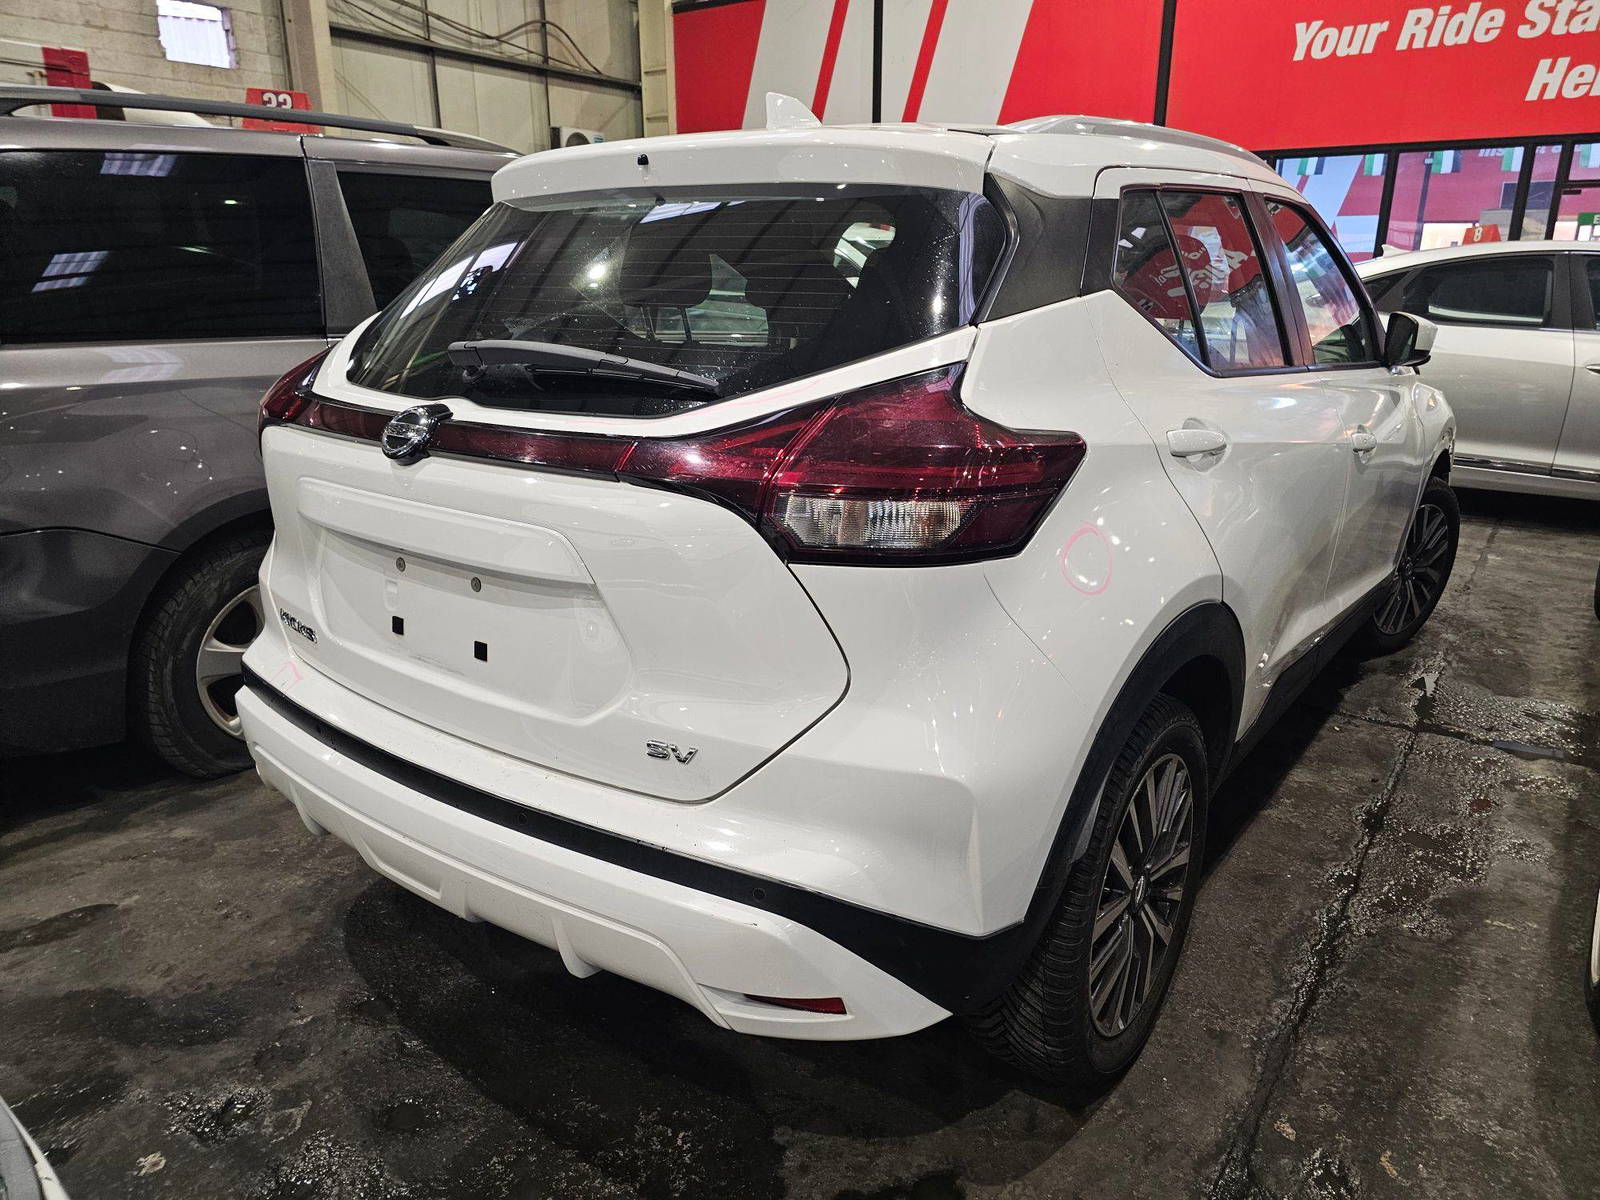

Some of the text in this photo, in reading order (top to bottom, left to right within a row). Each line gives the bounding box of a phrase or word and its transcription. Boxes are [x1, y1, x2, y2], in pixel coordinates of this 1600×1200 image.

[1293, 20, 1390, 61] Your
[1395, 2, 1505, 50] Ride
[646, 740, 698, 765] SV
